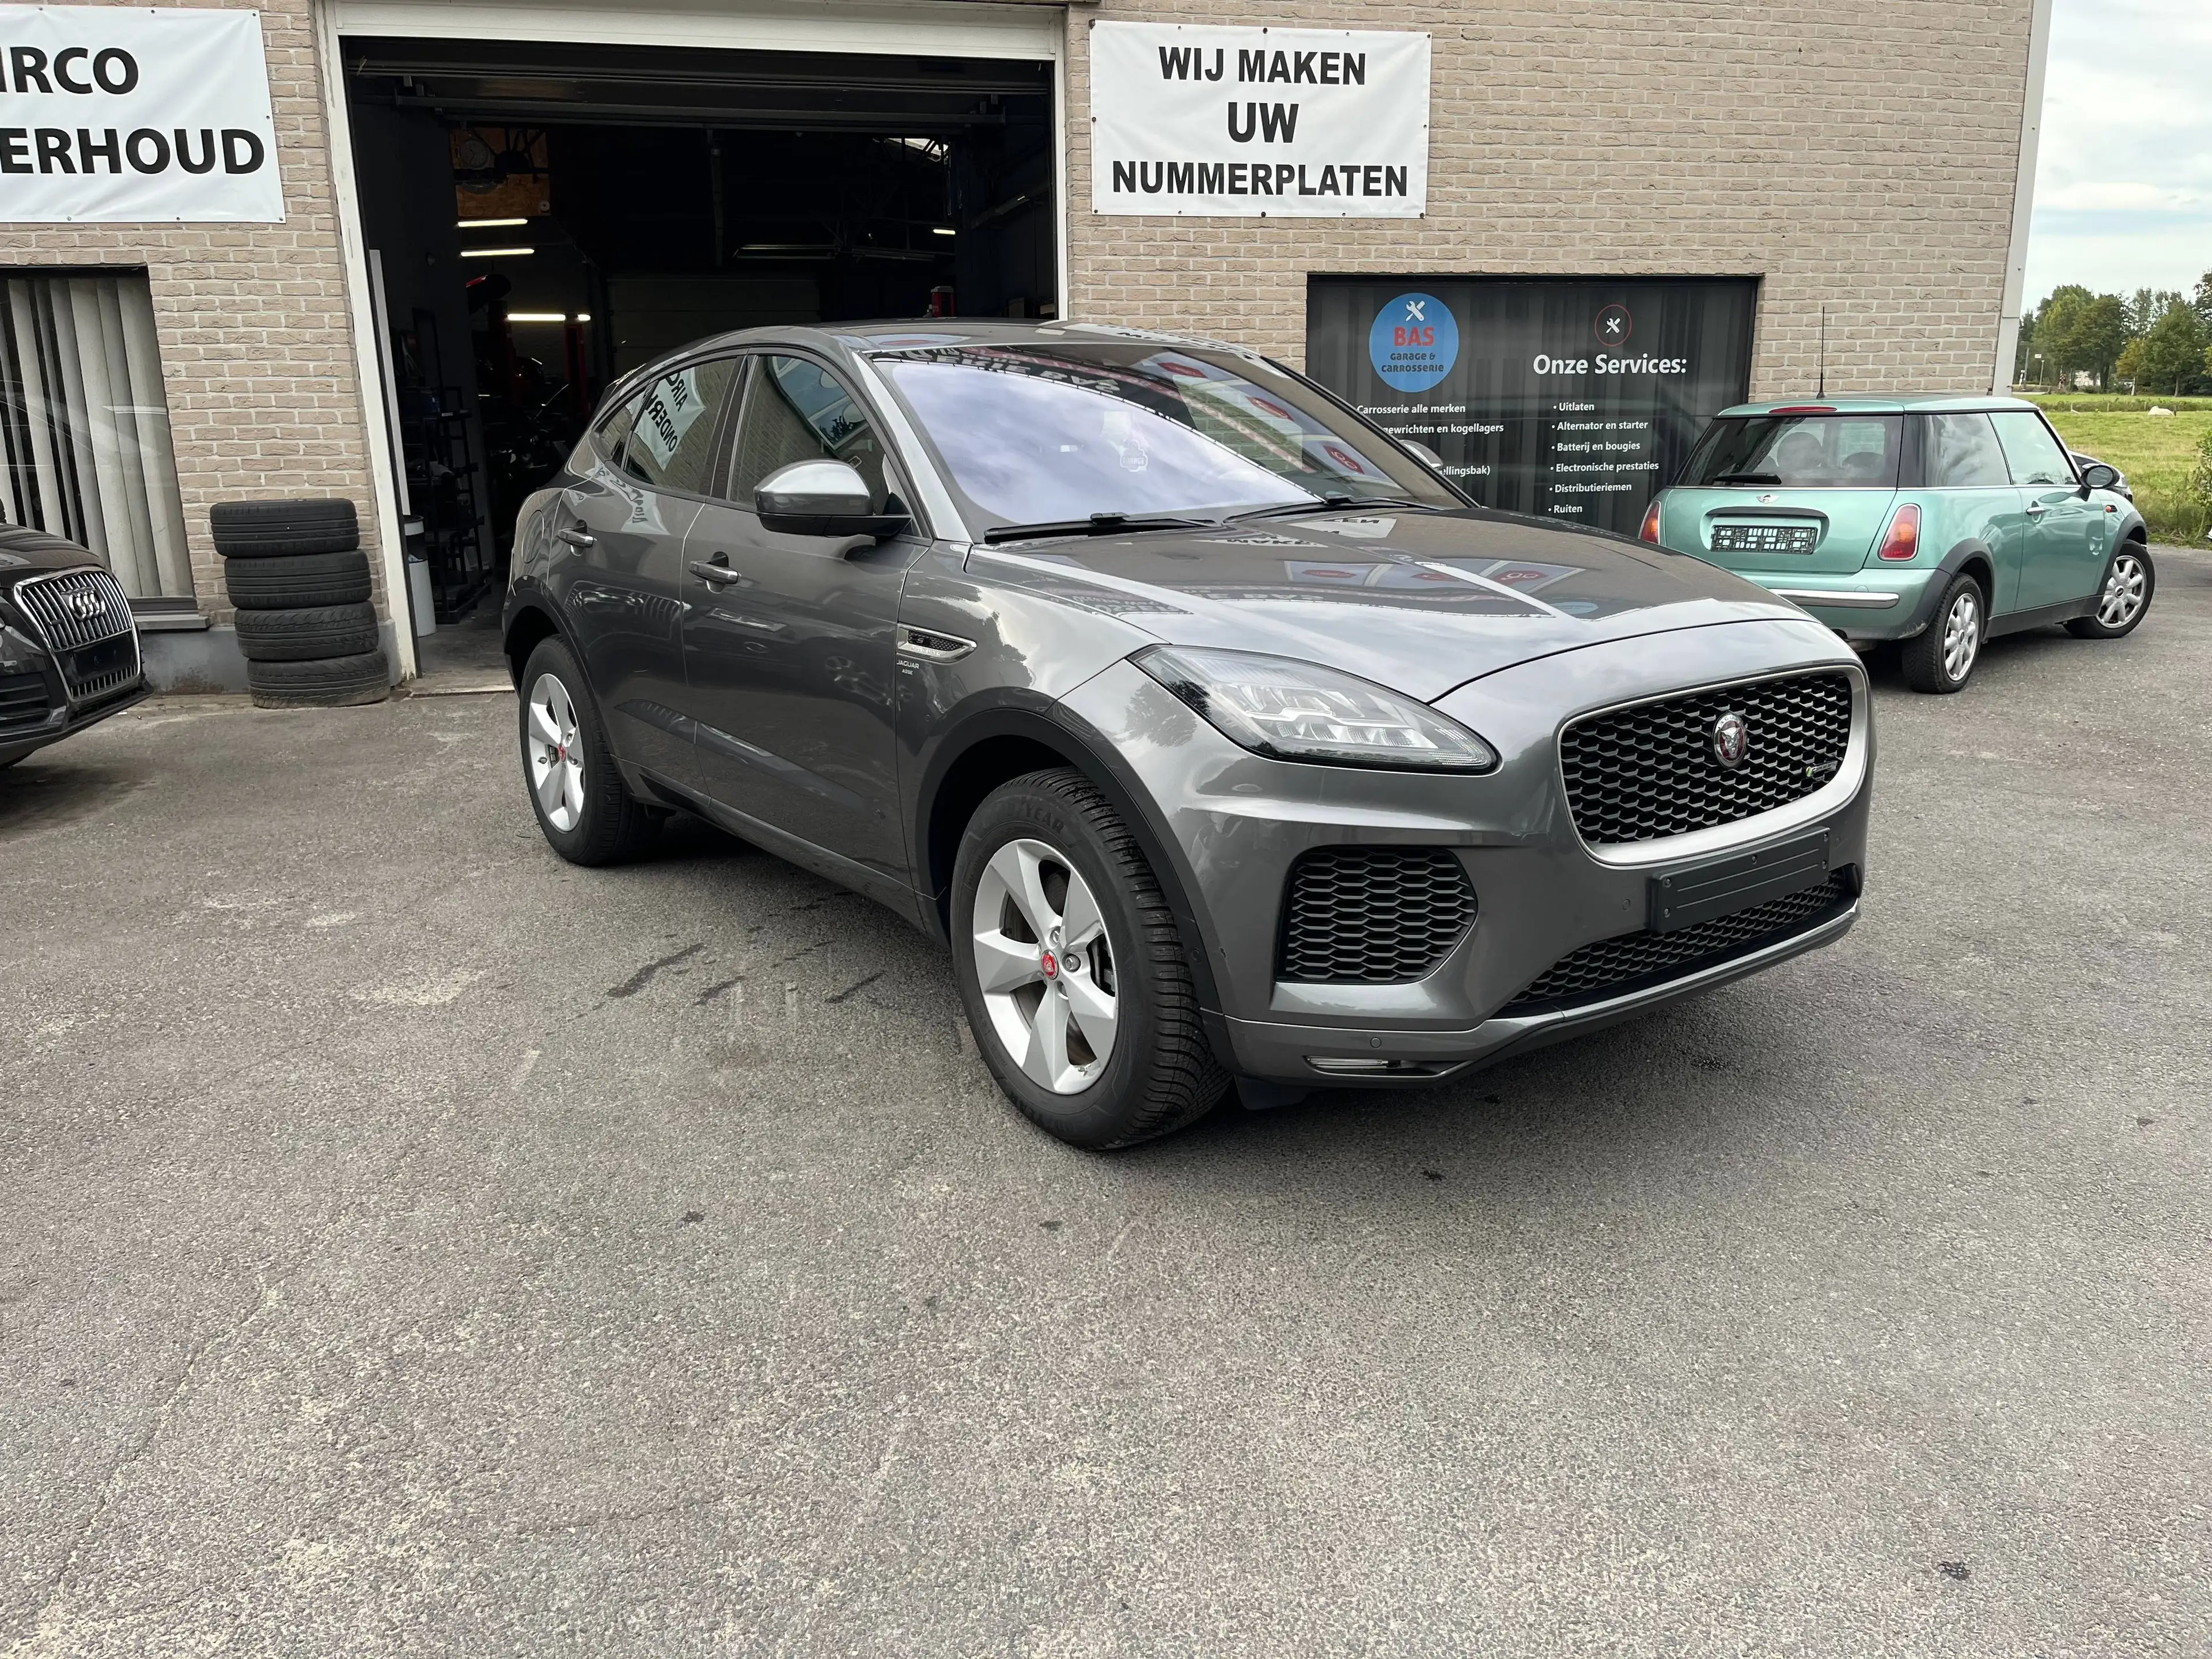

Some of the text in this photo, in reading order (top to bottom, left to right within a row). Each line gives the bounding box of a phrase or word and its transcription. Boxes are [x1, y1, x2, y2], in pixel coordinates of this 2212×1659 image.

[1158, 46, 1366, 85] WIJ MAKEN
[1228, 102, 1299, 143] UW
[0, 128, 265, 175] ERHOUD
[1112, 161, 1407, 196] NUMMERPLATEN
[1394, 326, 1434, 347] BAS
[1533, 353, 1687, 374] Onze Services:
[1357, 404, 1466, 414] Carrosserie alle merken
[1559, 402, 1594, 411] Uitlaten
[1451, 423, 1504, 435] kogellagers
[1557, 422, 1603, 430] Alternator
[1619, 421, 1648, 429] starter
[1557, 442, 1590, 452] Batterij
[1605, 441, 1641, 452] bougies
[1556, 461, 1659, 472] Electronische prestaties
[1555, 483, 1632, 493] Distributieriemen
[1554, 505, 1582, 513] Ruiten
[896, 660, 919, 669] JAGUAR
